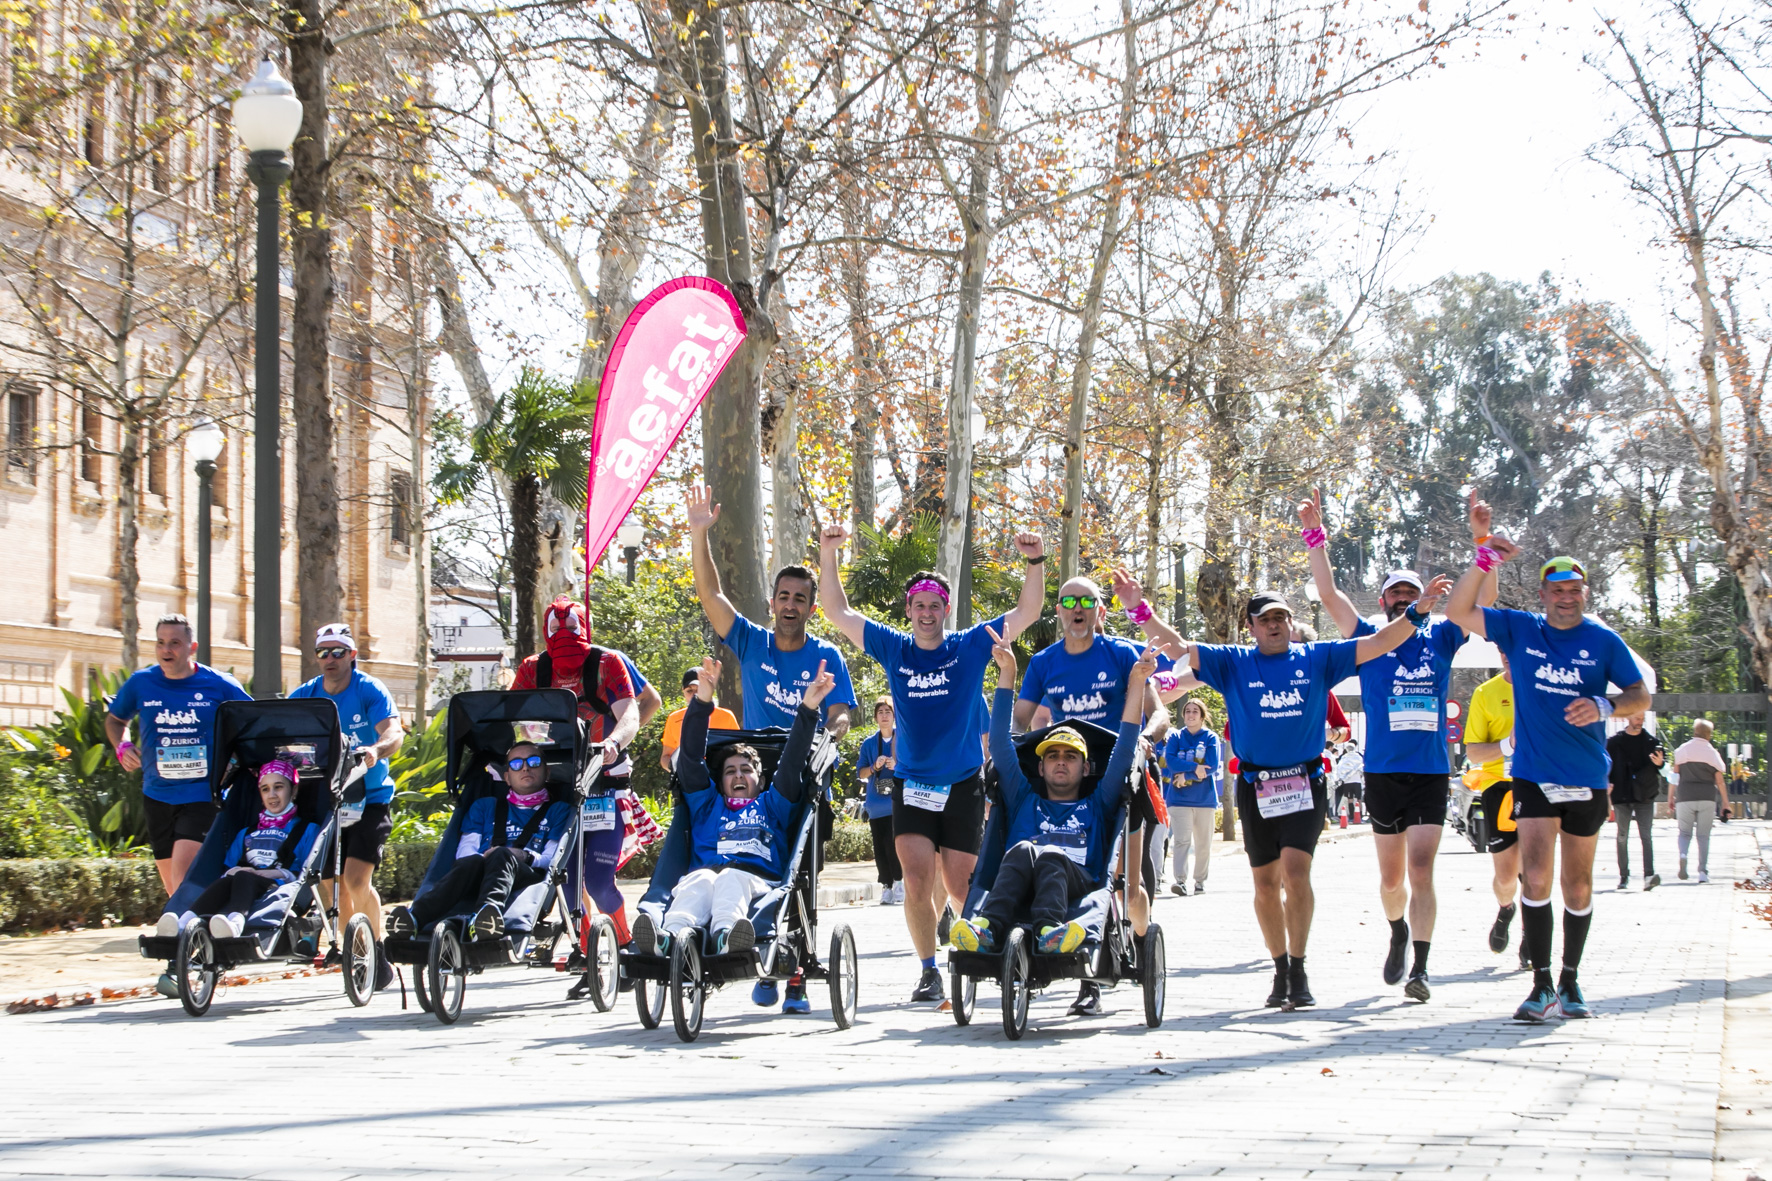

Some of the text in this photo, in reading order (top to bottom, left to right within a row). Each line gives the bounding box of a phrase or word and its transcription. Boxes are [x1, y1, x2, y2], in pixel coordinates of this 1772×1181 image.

[607, 312, 729, 480] aefat
[627, 329, 737, 490] www.aefat.es
[761, 662, 778, 676] aefat
[1091, 681, 1116, 690] ZURICH
[908, 689, 949, 698] #Imparables
[1261, 710, 1302, 719] #Imparables
[349, 721, 369, 729] ZURICH
[172, 737, 200, 745] ZURICH
[1271, 767, 1301, 778] ZURICH
[1273, 783, 1292, 793] 7516
[738, 818, 769, 829] ZURICH
[261, 829, 289, 839] ZURICH
